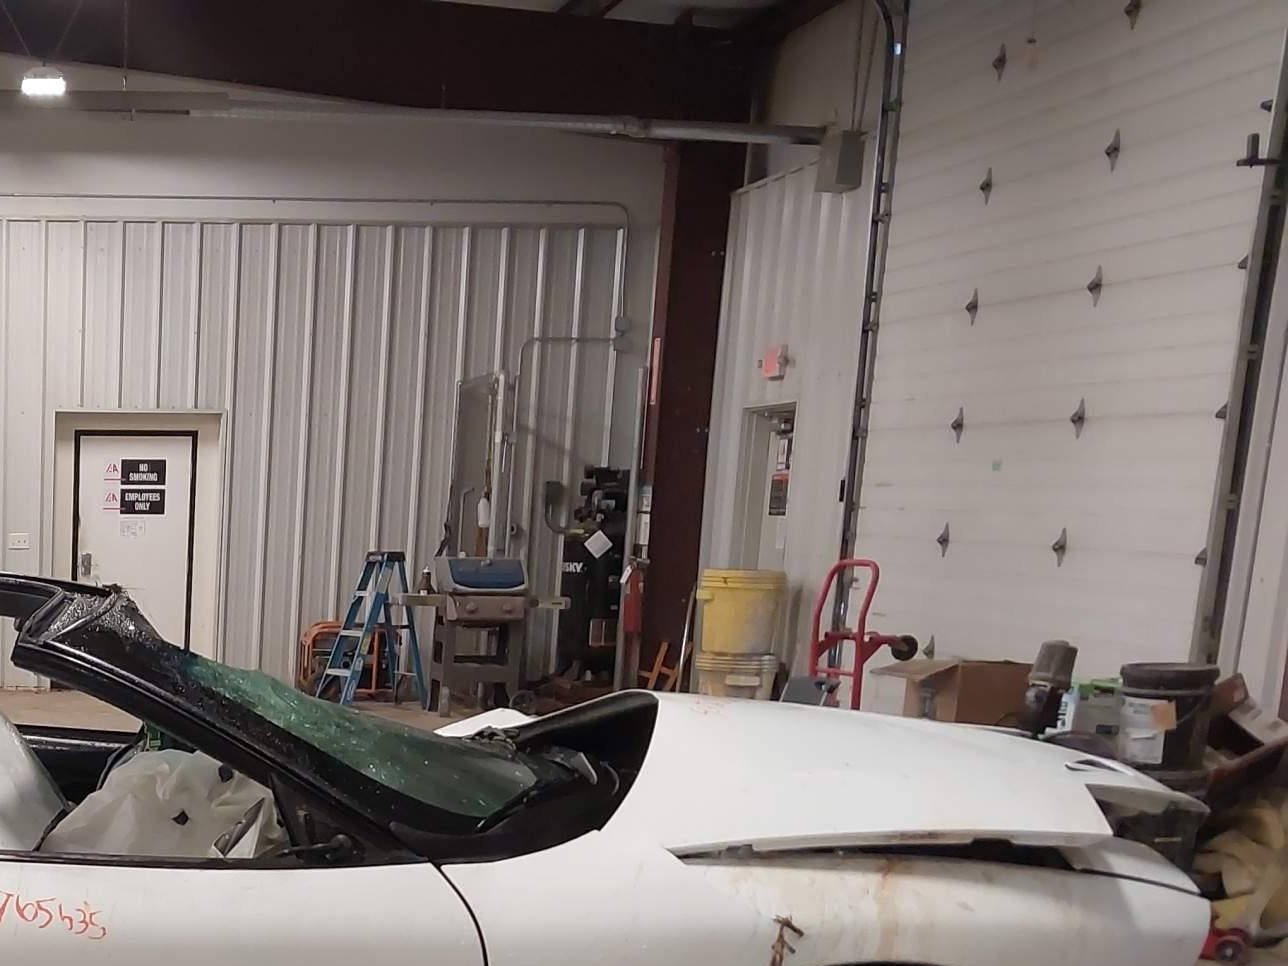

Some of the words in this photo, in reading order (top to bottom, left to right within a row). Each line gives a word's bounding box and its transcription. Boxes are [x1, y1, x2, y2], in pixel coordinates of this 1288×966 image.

[139, 463, 148, 472] NO
[129, 473, 158, 482] SMOKING
[124, 492, 161, 502] EMPLOYEES
[134, 502, 151, 511] ONLY
